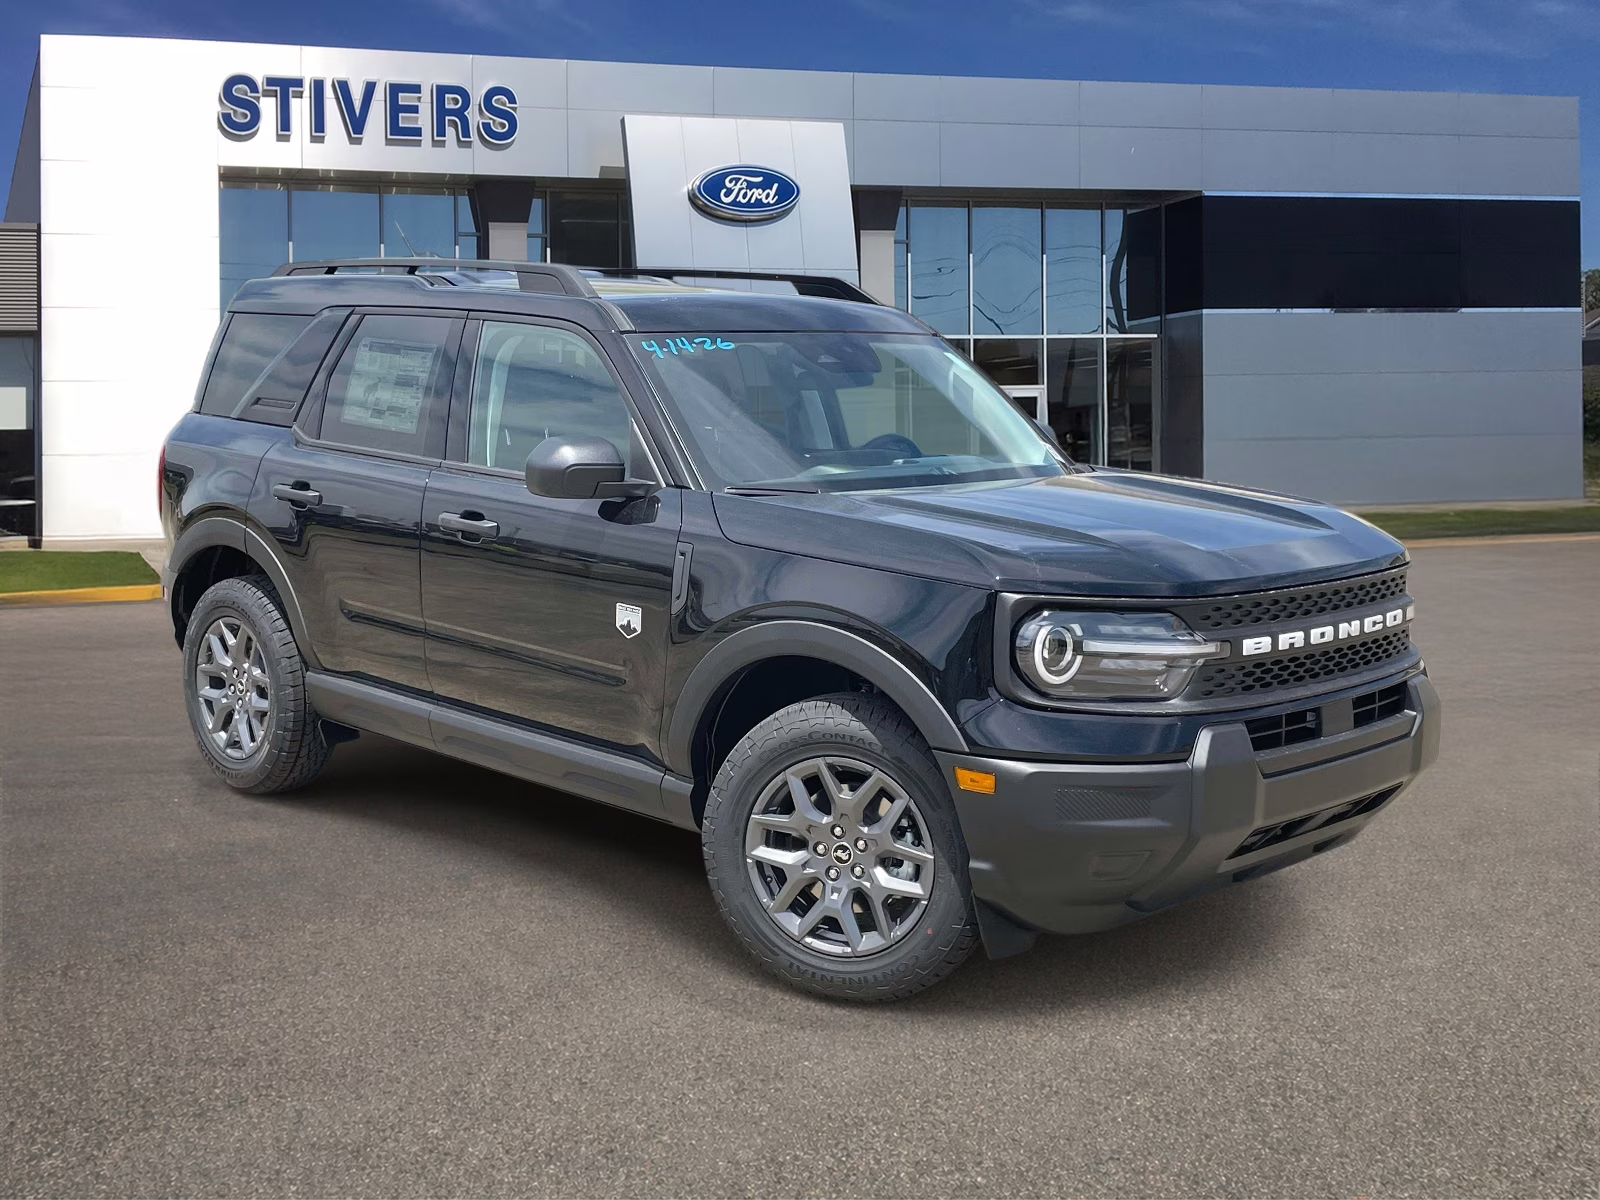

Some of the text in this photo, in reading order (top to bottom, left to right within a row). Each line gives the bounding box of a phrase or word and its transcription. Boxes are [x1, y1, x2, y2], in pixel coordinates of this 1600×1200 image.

[218, 73, 519, 146] STIVERS
[720, 174, 779, 204] Ford
[1242, 608, 1403, 656] BRONCO
